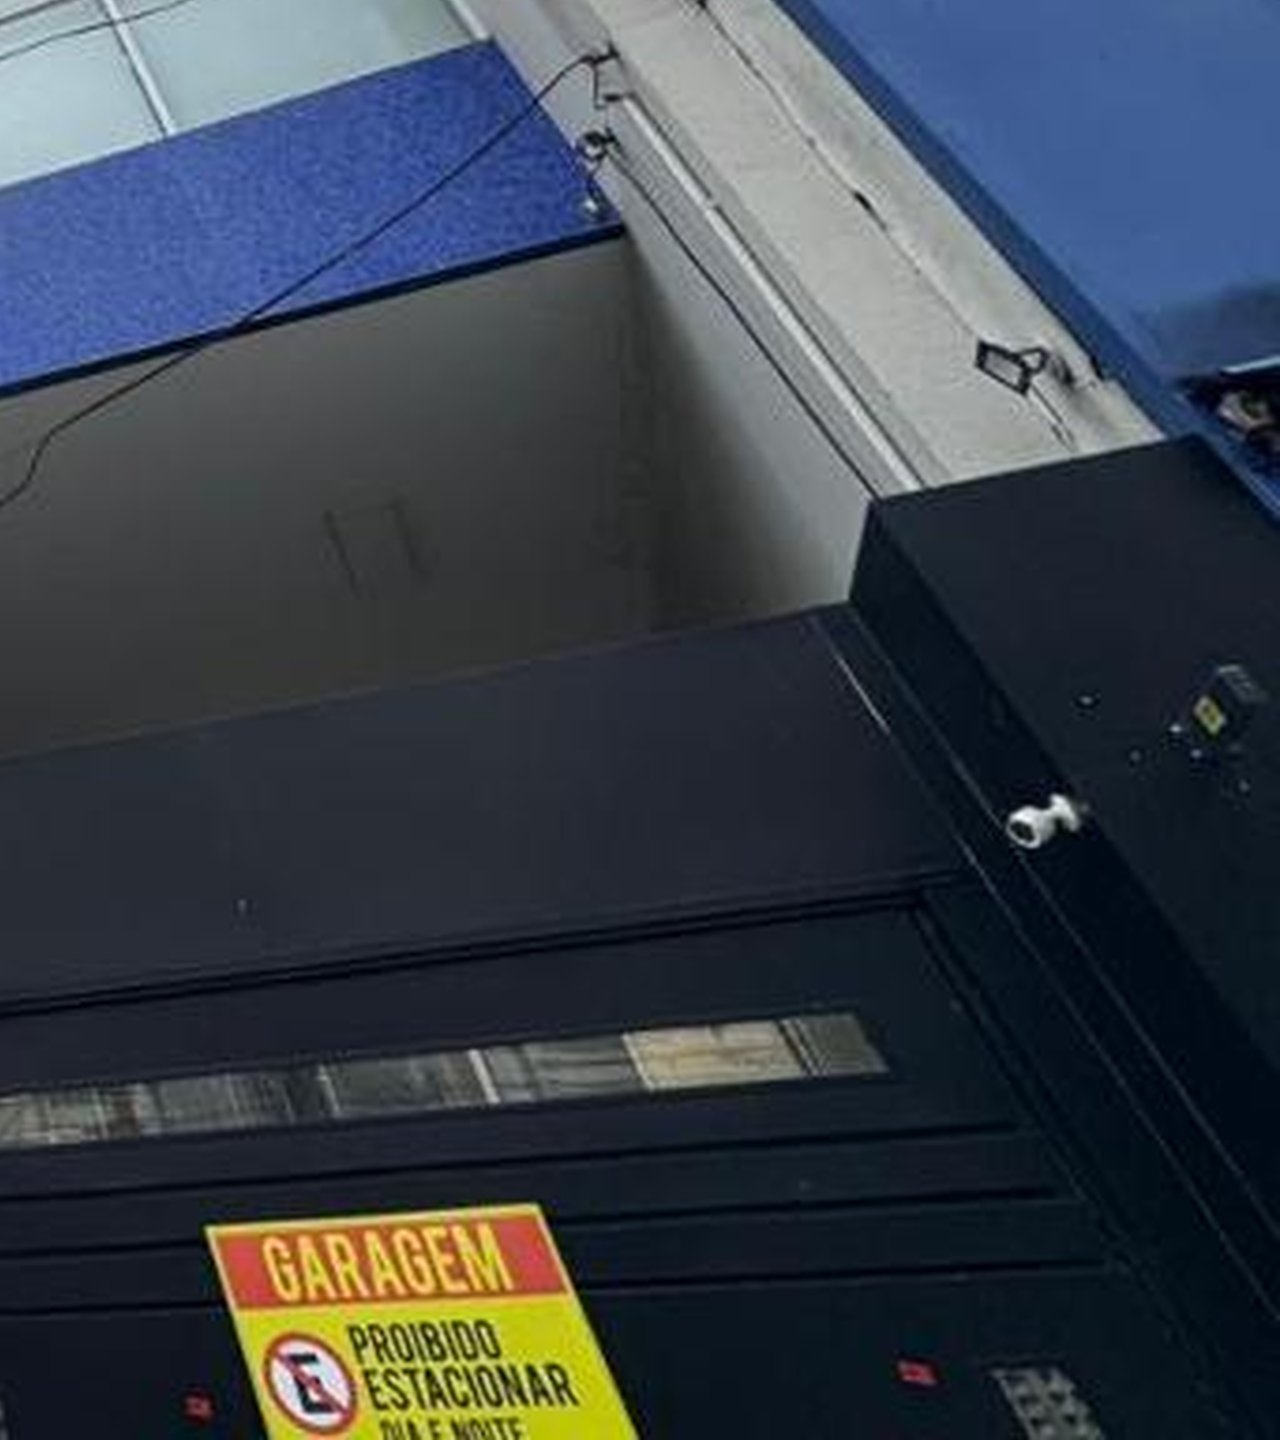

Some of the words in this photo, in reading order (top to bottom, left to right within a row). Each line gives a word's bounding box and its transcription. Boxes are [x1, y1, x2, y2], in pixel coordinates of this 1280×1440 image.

[262, 1222, 514, 1302] GARAGEM
[347, 1320, 502, 1364] PROIBIDO
[363, 1364, 580, 1411] ESTACIONAR
